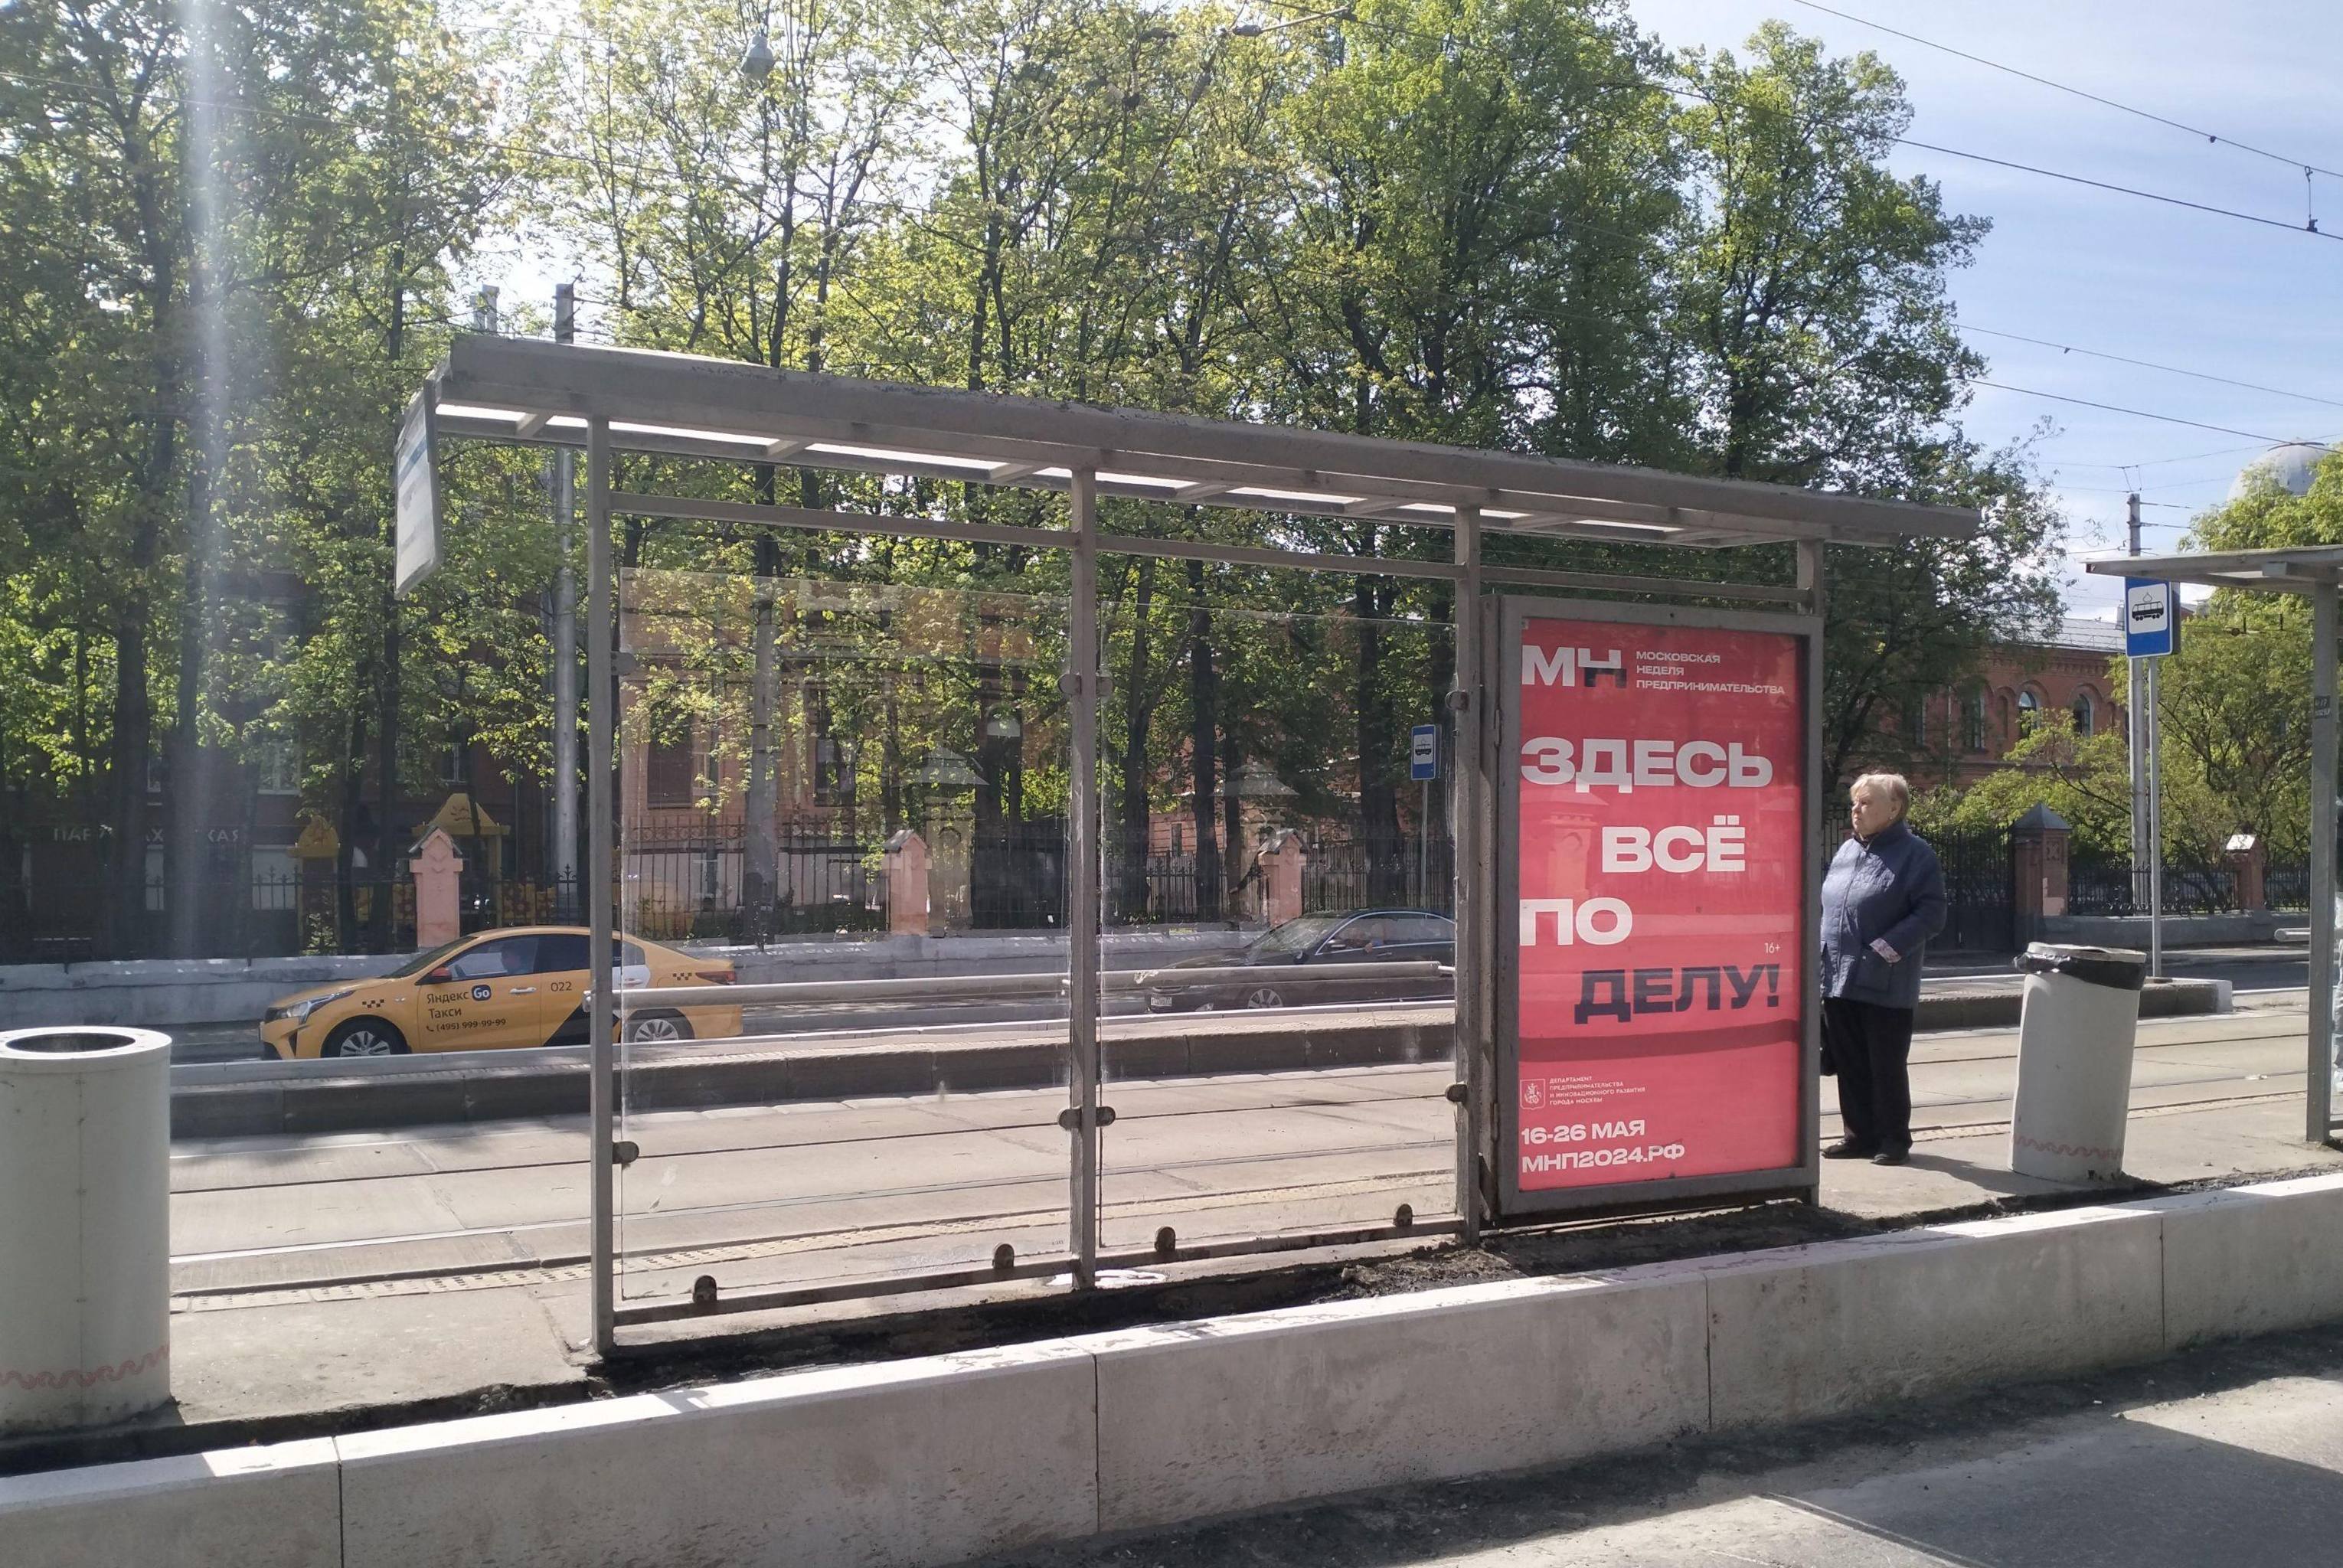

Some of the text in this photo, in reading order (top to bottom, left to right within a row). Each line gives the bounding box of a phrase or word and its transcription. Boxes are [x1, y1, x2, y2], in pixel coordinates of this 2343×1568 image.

[1636, 651, 1721, 664] МОСКОВСКАЯ
[1636, 665, 1685, 676] НЕДЕЛЯ
[1636, 679, 1785, 695] ПРЕДПРИНИМАТЕЛЬСТВА
[1521, 737, 1773, 793] ЗДЕСЬ
[1602, 815, 1746, 873] ВСЁ
[1519, 897, 1633, 946] ПО
[1764, 942, 1781, 954] 16+
[551, 981, 573, 992] 022
[1574, 963, 1781, 1025] ДЕЛУ!
[426, 988, 490, 1004] Яндекс Go
[428, 1008, 462, 1020] Такси
[436, 1018, 506, 1032] (495) 999-99-99
[1549, 1076, 1593, 1084] ДЕПАРТАМЕНТ
[1521, 1119, 1645, 1145] 16-26 МАЯ
[1521, 1143, 1685, 1173] МНП2024.РФ
